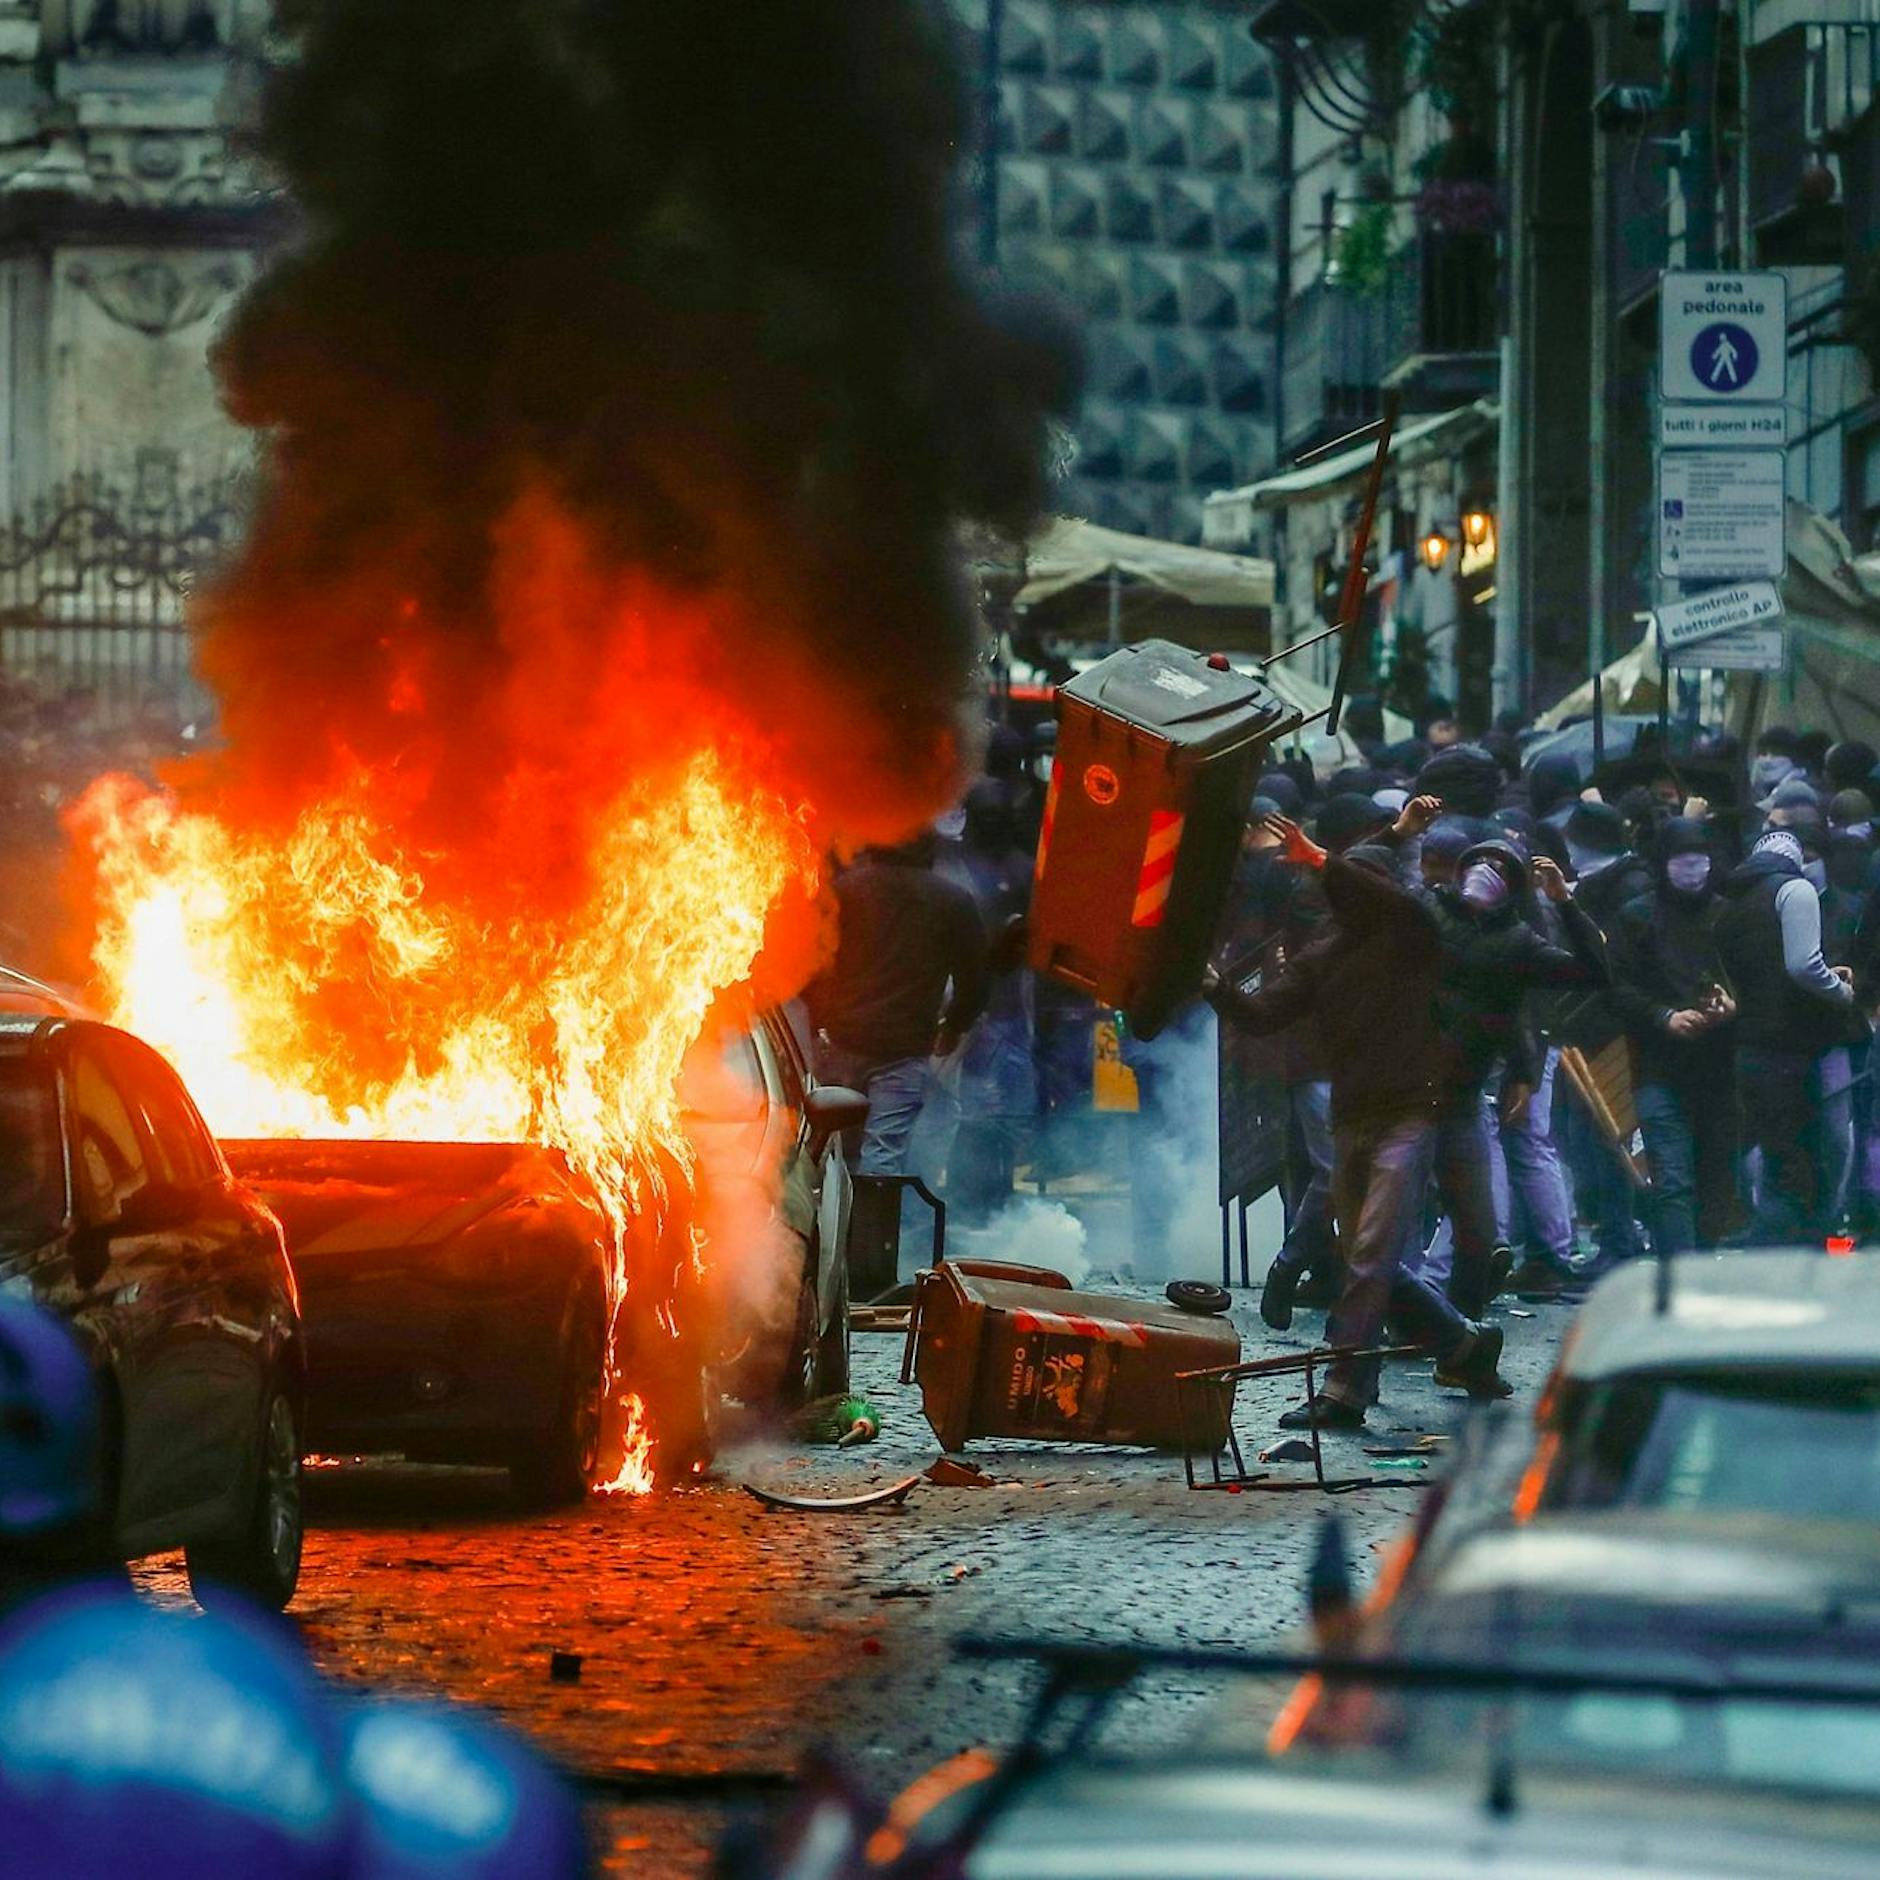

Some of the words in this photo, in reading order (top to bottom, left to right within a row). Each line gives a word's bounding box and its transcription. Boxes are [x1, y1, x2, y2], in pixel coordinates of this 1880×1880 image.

[1705, 281, 1743, 294] area
[1683, 299, 1765, 315] pedonale
[1665, 420, 1696, 432] tutti
[1708, 420, 1747, 433] giorni
[1751, 420, 1781, 431] H24
[1685, 590, 1749, 616] controllo
[1672, 609, 1749, 637] elettronico
[1753, 600, 1772, 615] AP
[1008, 1347, 1026, 1410] UMIDO
